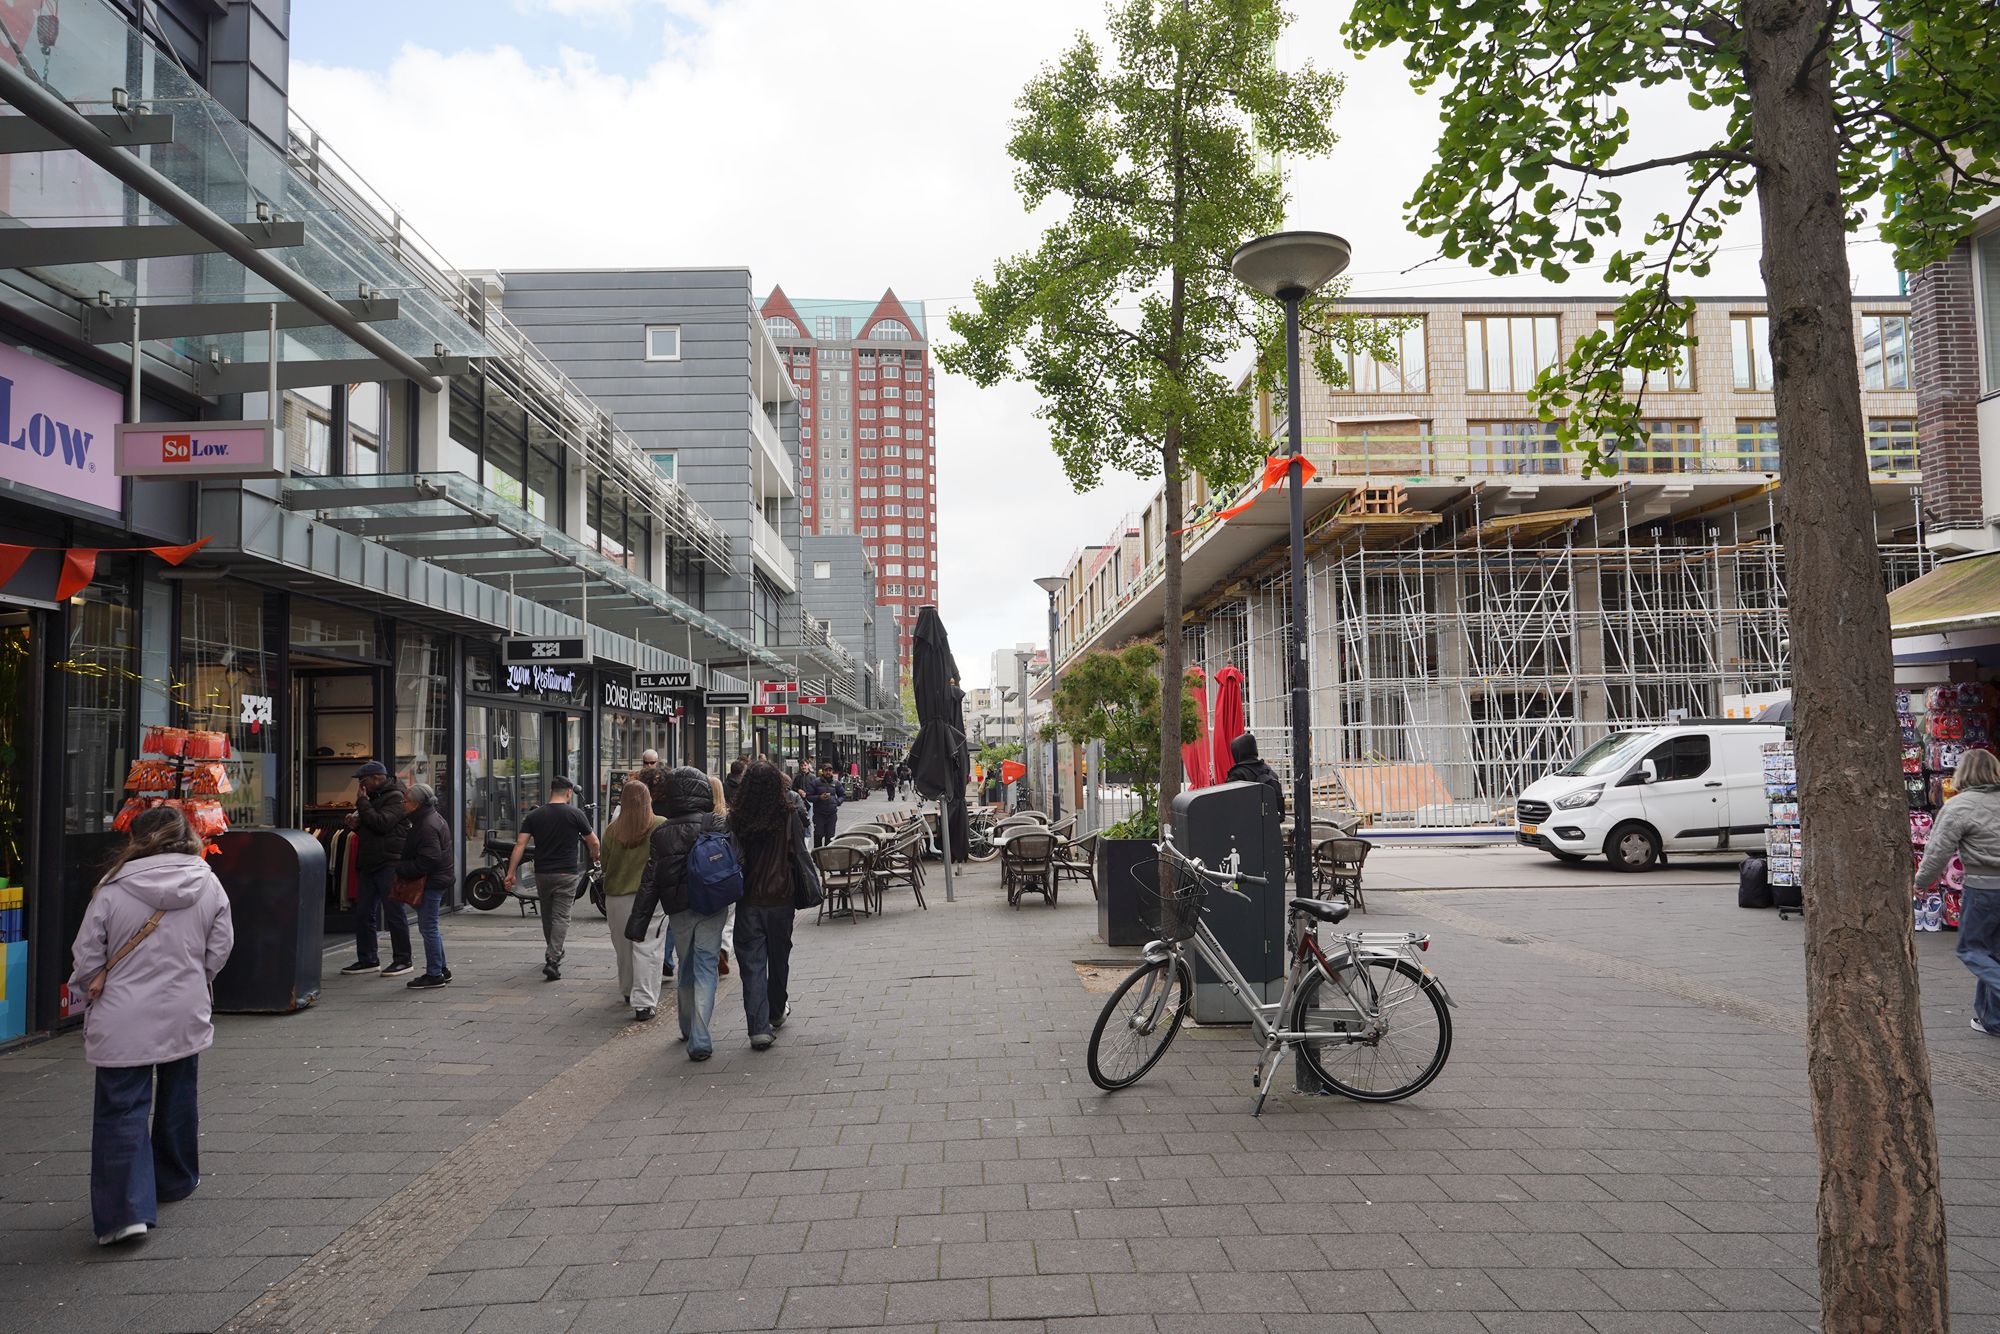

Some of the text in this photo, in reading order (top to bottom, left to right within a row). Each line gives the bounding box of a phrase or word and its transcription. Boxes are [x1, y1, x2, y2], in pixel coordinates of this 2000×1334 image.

[640, 676, 687, 686] EL AVIV
[605, 680, 629, 708] DÖNER
[629, 689, 648, 711] KEBAP
[653, 694, 675, 716] FALAFEL
